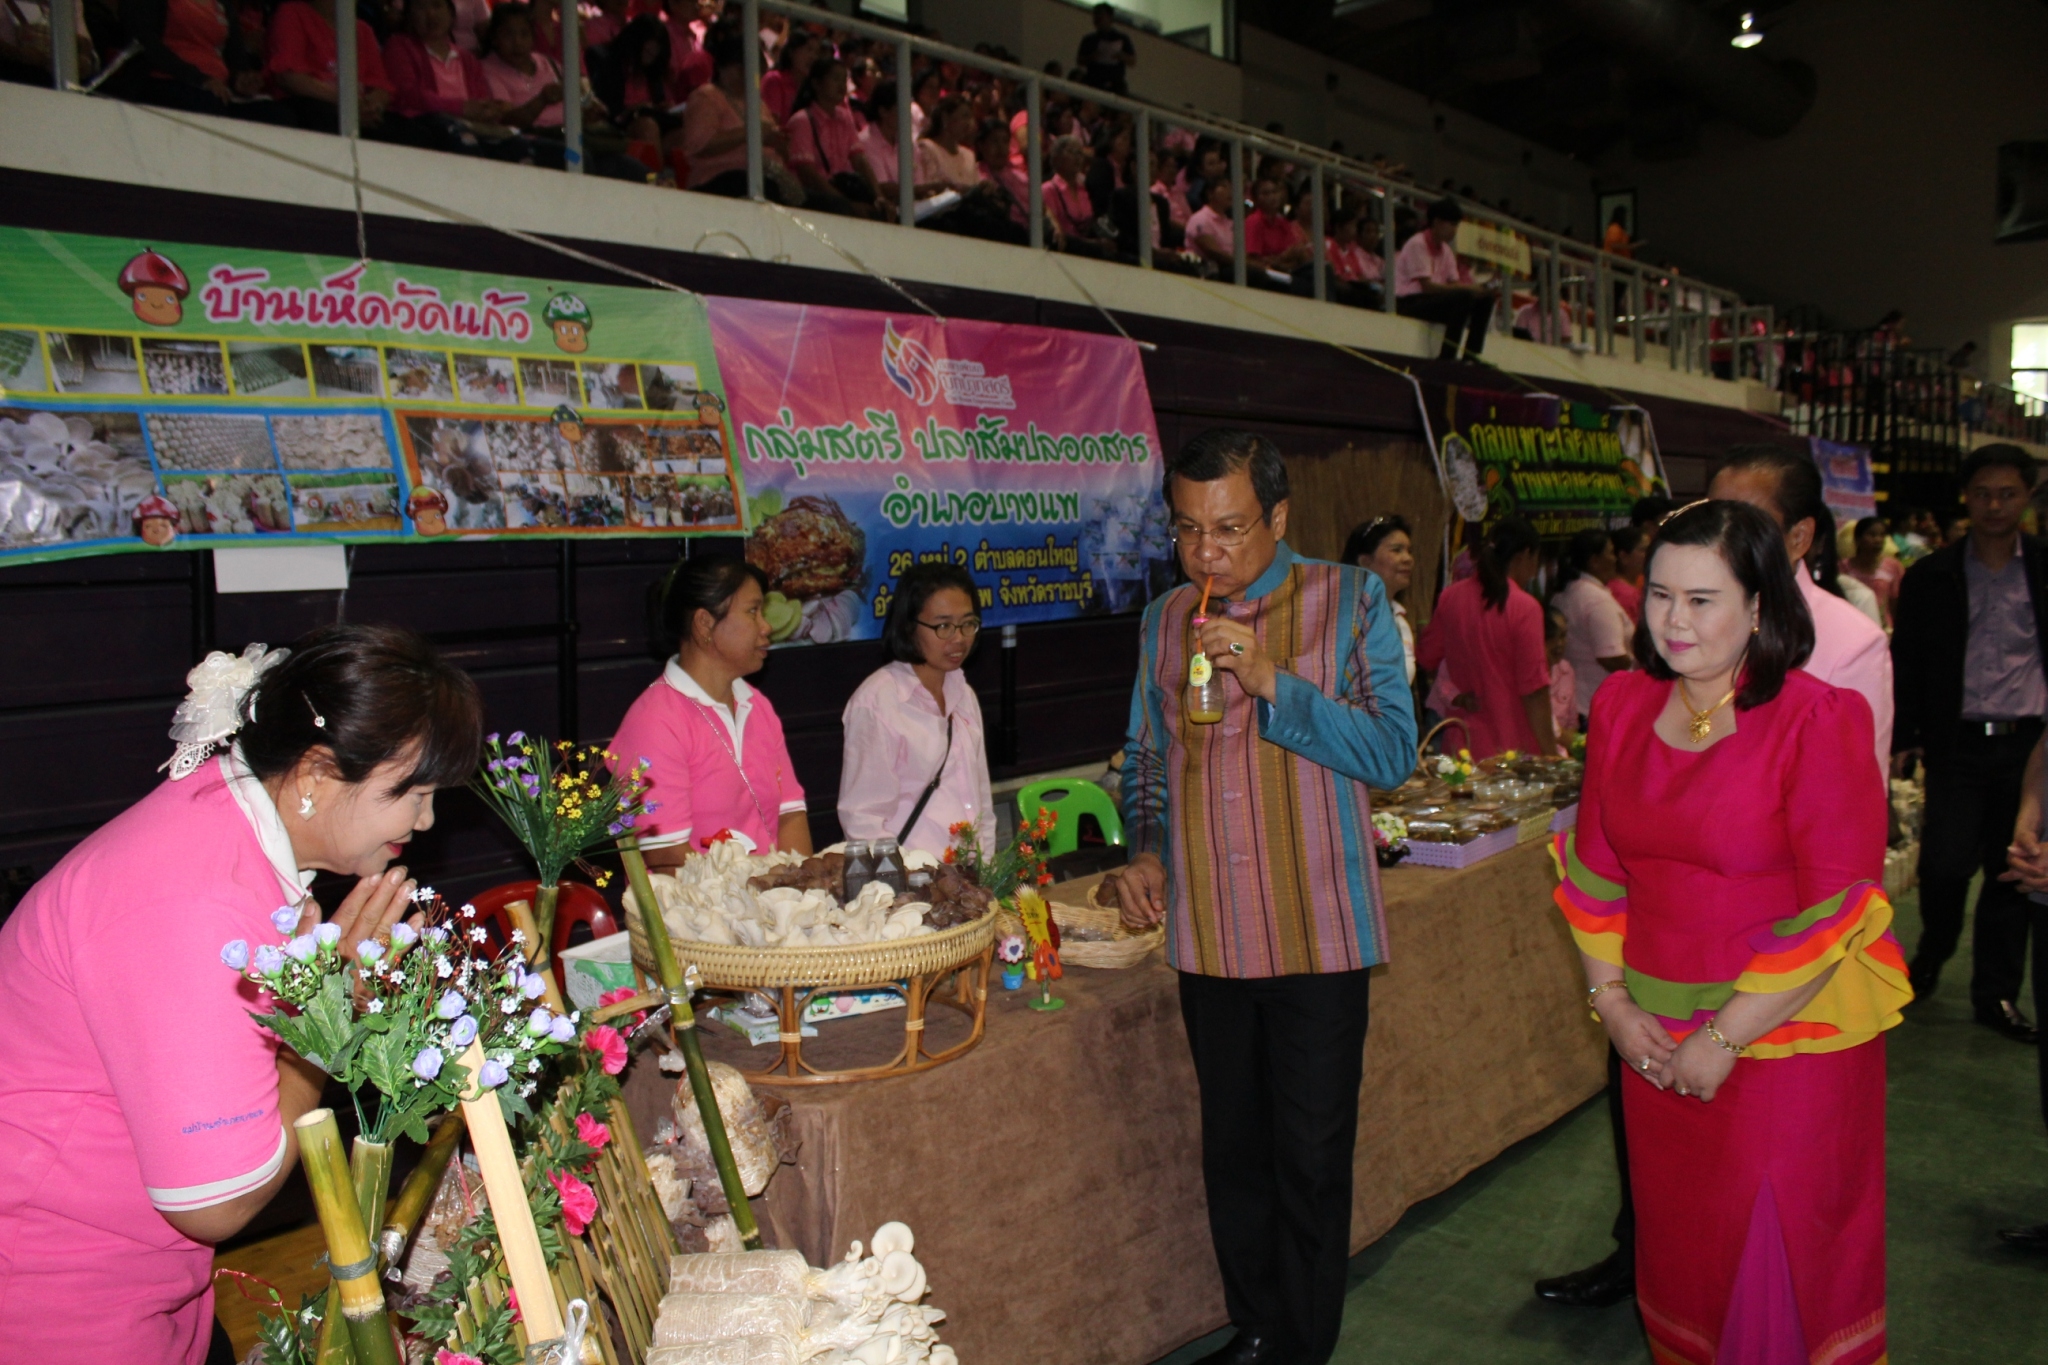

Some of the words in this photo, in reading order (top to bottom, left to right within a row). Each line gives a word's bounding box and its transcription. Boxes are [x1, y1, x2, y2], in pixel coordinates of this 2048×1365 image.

[203, 262, 531, 341] บ้านเห็ดวัดแก้ว
[743, 409, 902, 477] กลุ่มสตรี
[914, 415, 1149, 463] ปลาส้มปลอดสาร
[882, 475, 1080, 525] อำเภอบางแพ
[889, 552, 913, 576] 26
[974, 535, 1079, 573] ตำบลดอนใหญ่
[999, 572, 1093, 609] จังหวัดราชบุรี
